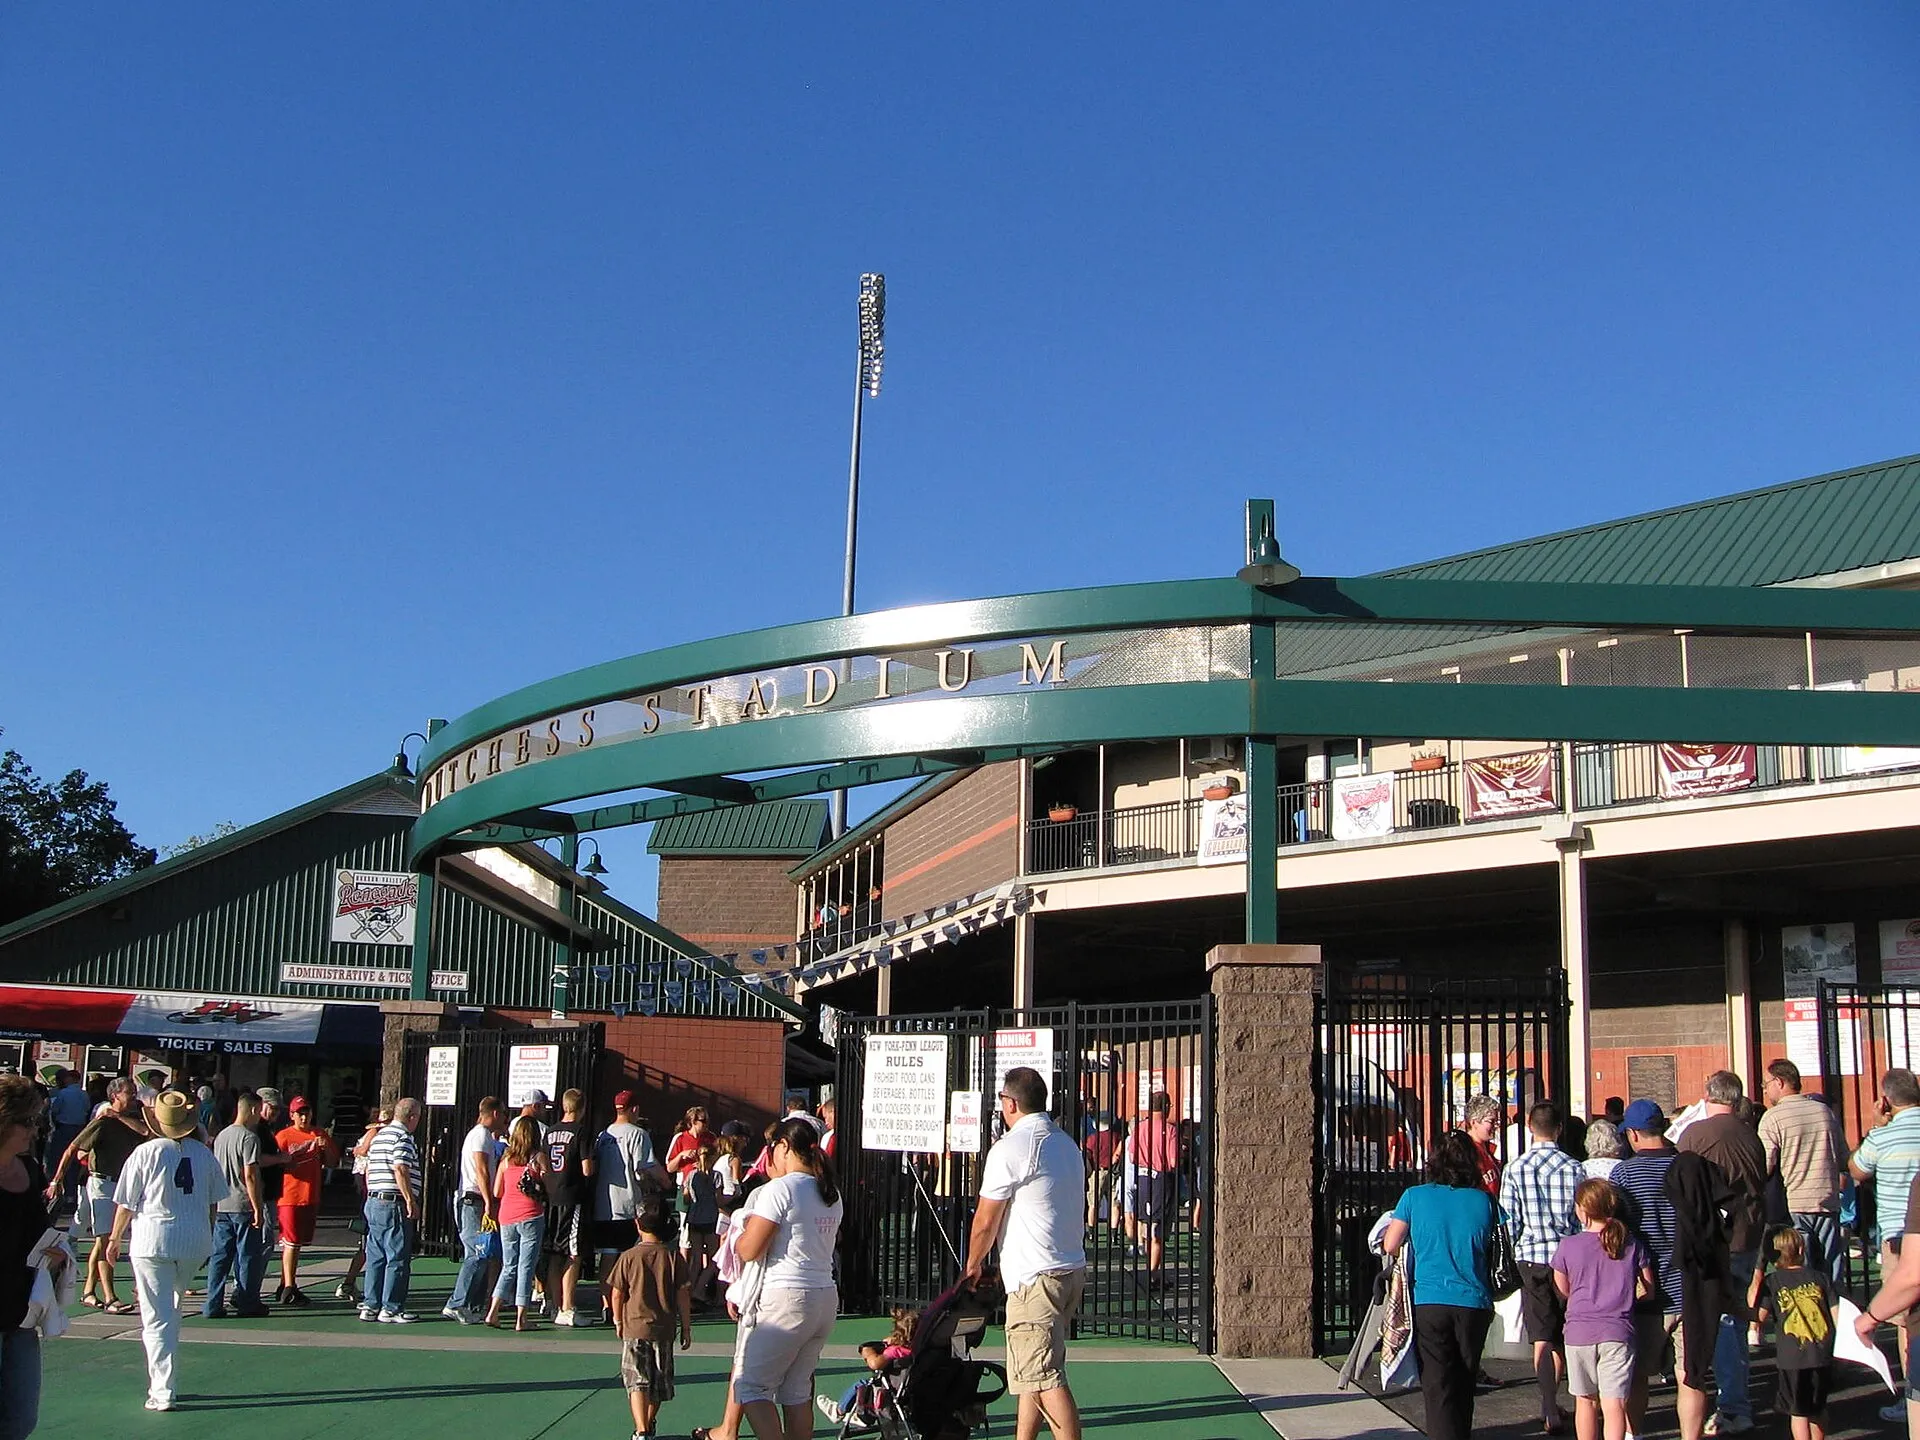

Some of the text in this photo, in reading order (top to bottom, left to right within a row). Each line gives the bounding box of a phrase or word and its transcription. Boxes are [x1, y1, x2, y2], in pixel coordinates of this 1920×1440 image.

[424, 640, 1069, 811] DUTCHESS STADIUM
[288, 966, 375, 982] ADMINISTRATIVE
[378, 972, 385, 982] &
[389, 972, 412, 983] TICK
[157, 1037, 273, 1054] TICKET SALES
[869, 1040, 881, 1051] NEW
[920, 1040, 944, 1052] LEAGUE
[996, 1033, 1032, 1047] ARNING
[886, 1056, 924, 1067] RULES
[920, 1072, 936, 1084] CANS
[909, 1088, 935, 1100] BOTTLES
[872, 1103, 936, 1116] AND COOLERS OF ANY
[865, 1118, 943, 1132] KIND FROM BEING BROUGHT
[876, 1133, 928, 1147] INTO THE STADIUM
[551, 1145, 565, 1171] 5
[174, 1157, 194, 1194] 4
